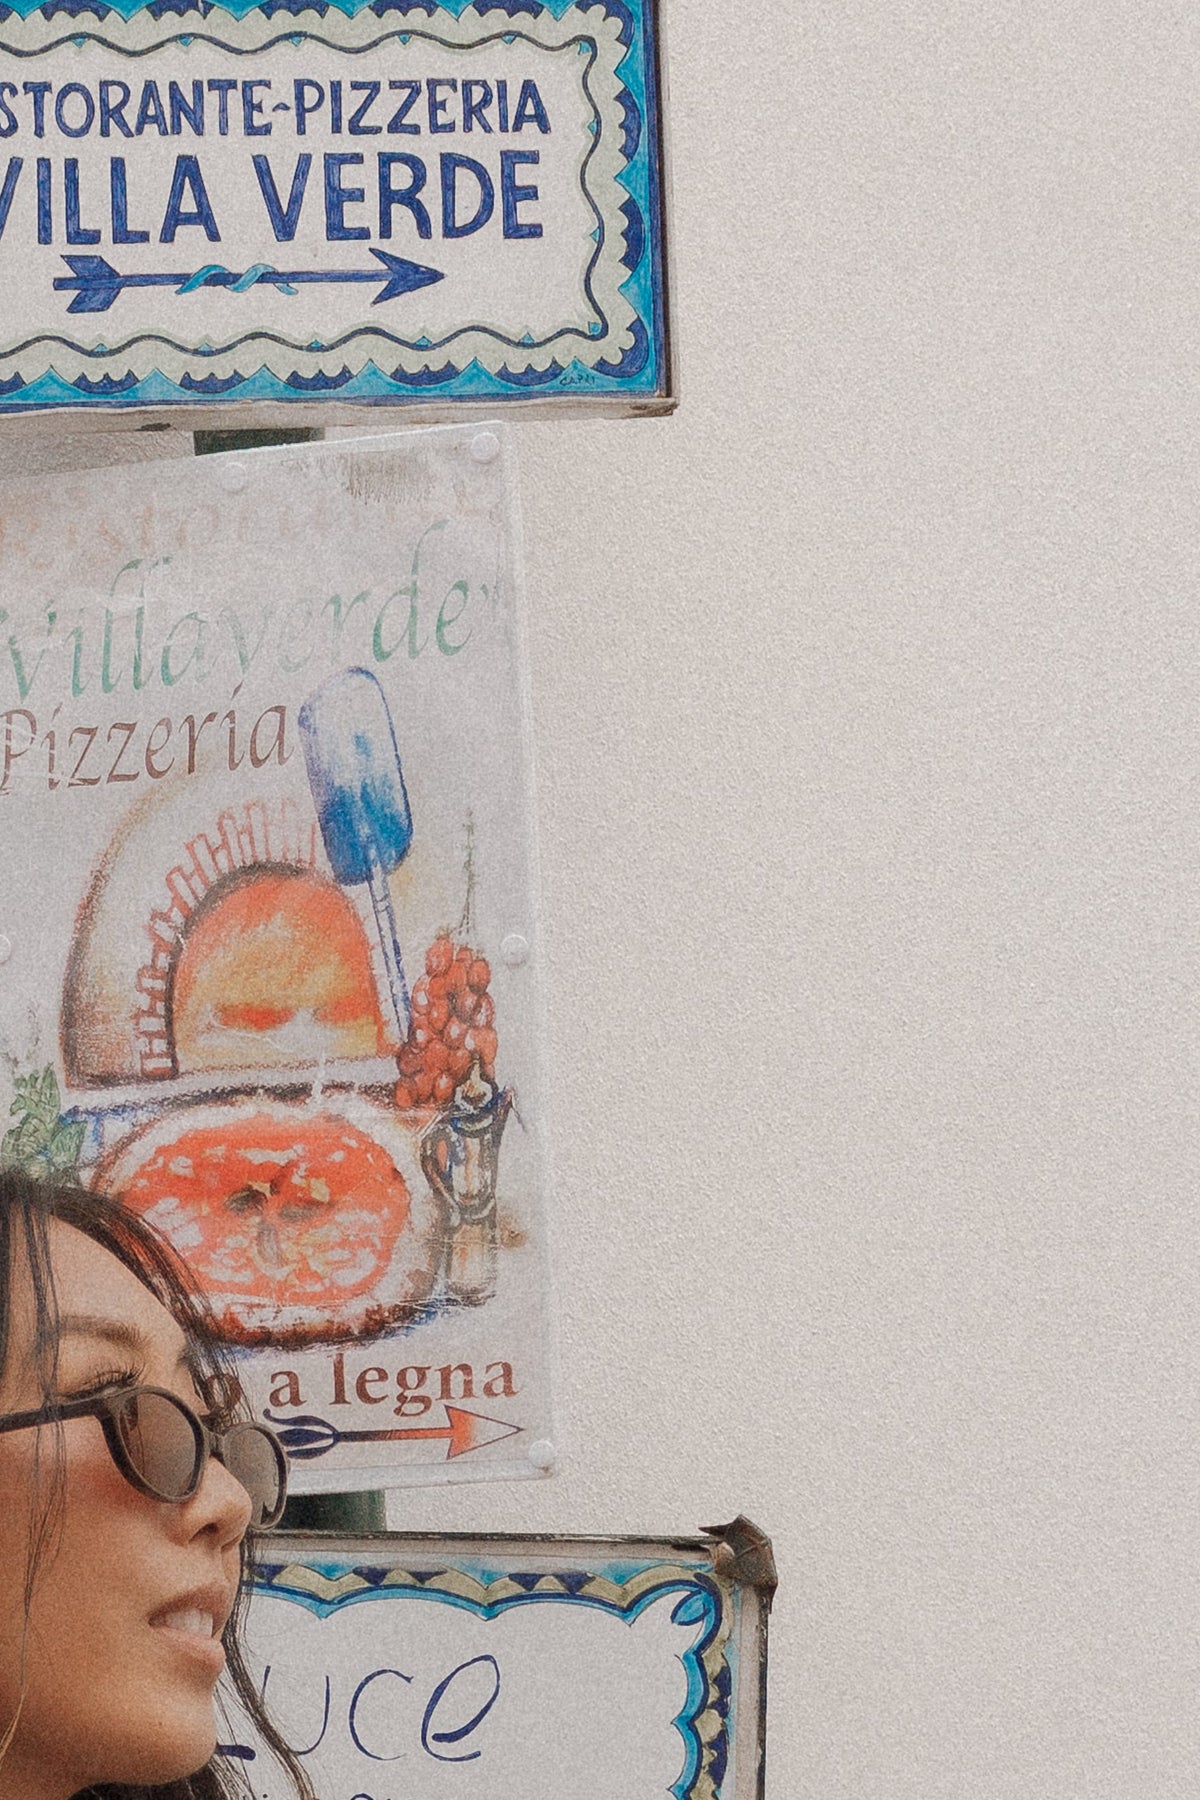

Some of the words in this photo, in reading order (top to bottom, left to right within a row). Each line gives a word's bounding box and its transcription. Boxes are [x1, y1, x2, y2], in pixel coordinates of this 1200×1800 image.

[252, 150, 543, 242] VERDE
[268, 1370, 307, 1408] a
[326, 1352, 520, 1417] legna
